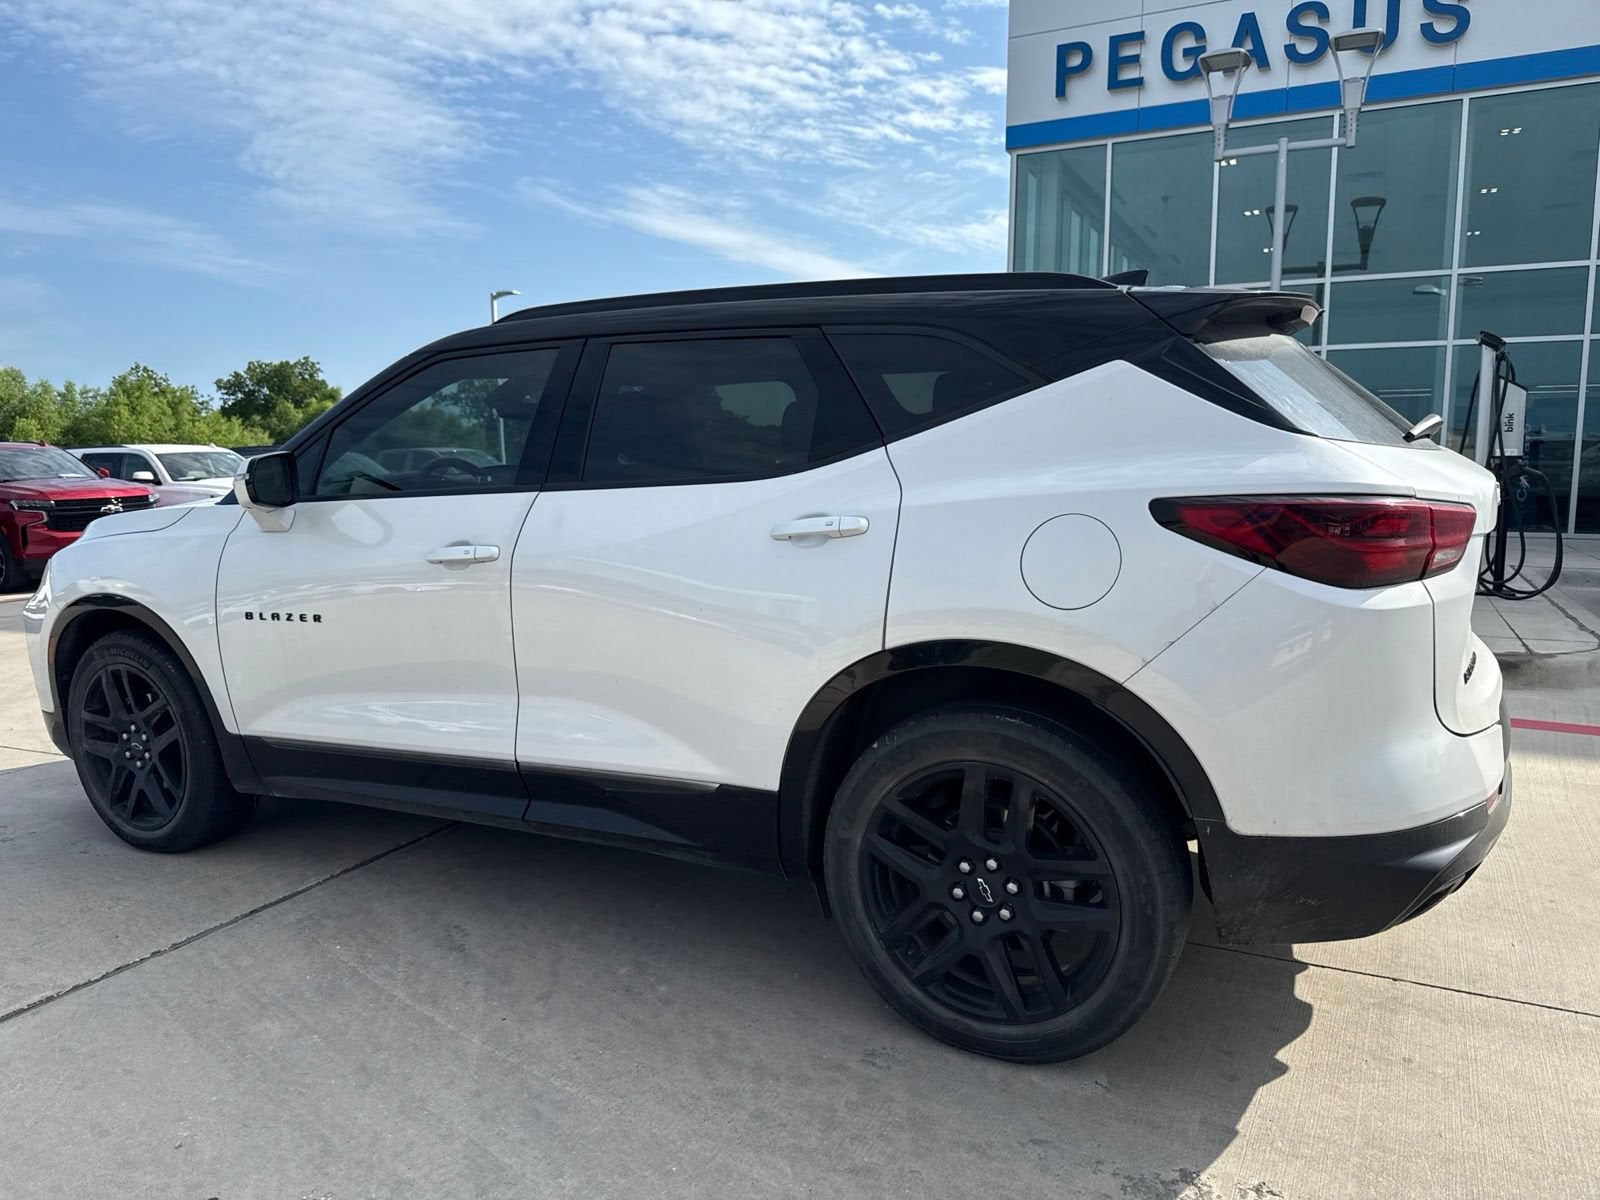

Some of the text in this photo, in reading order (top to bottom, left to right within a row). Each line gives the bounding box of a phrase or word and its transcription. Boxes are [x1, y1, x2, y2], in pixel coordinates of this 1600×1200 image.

[1055, 0, 1471, 99] PEGASUS
[1504, 413, 1515, 432] blink
[245, 612, 322, 623] BLAZER
